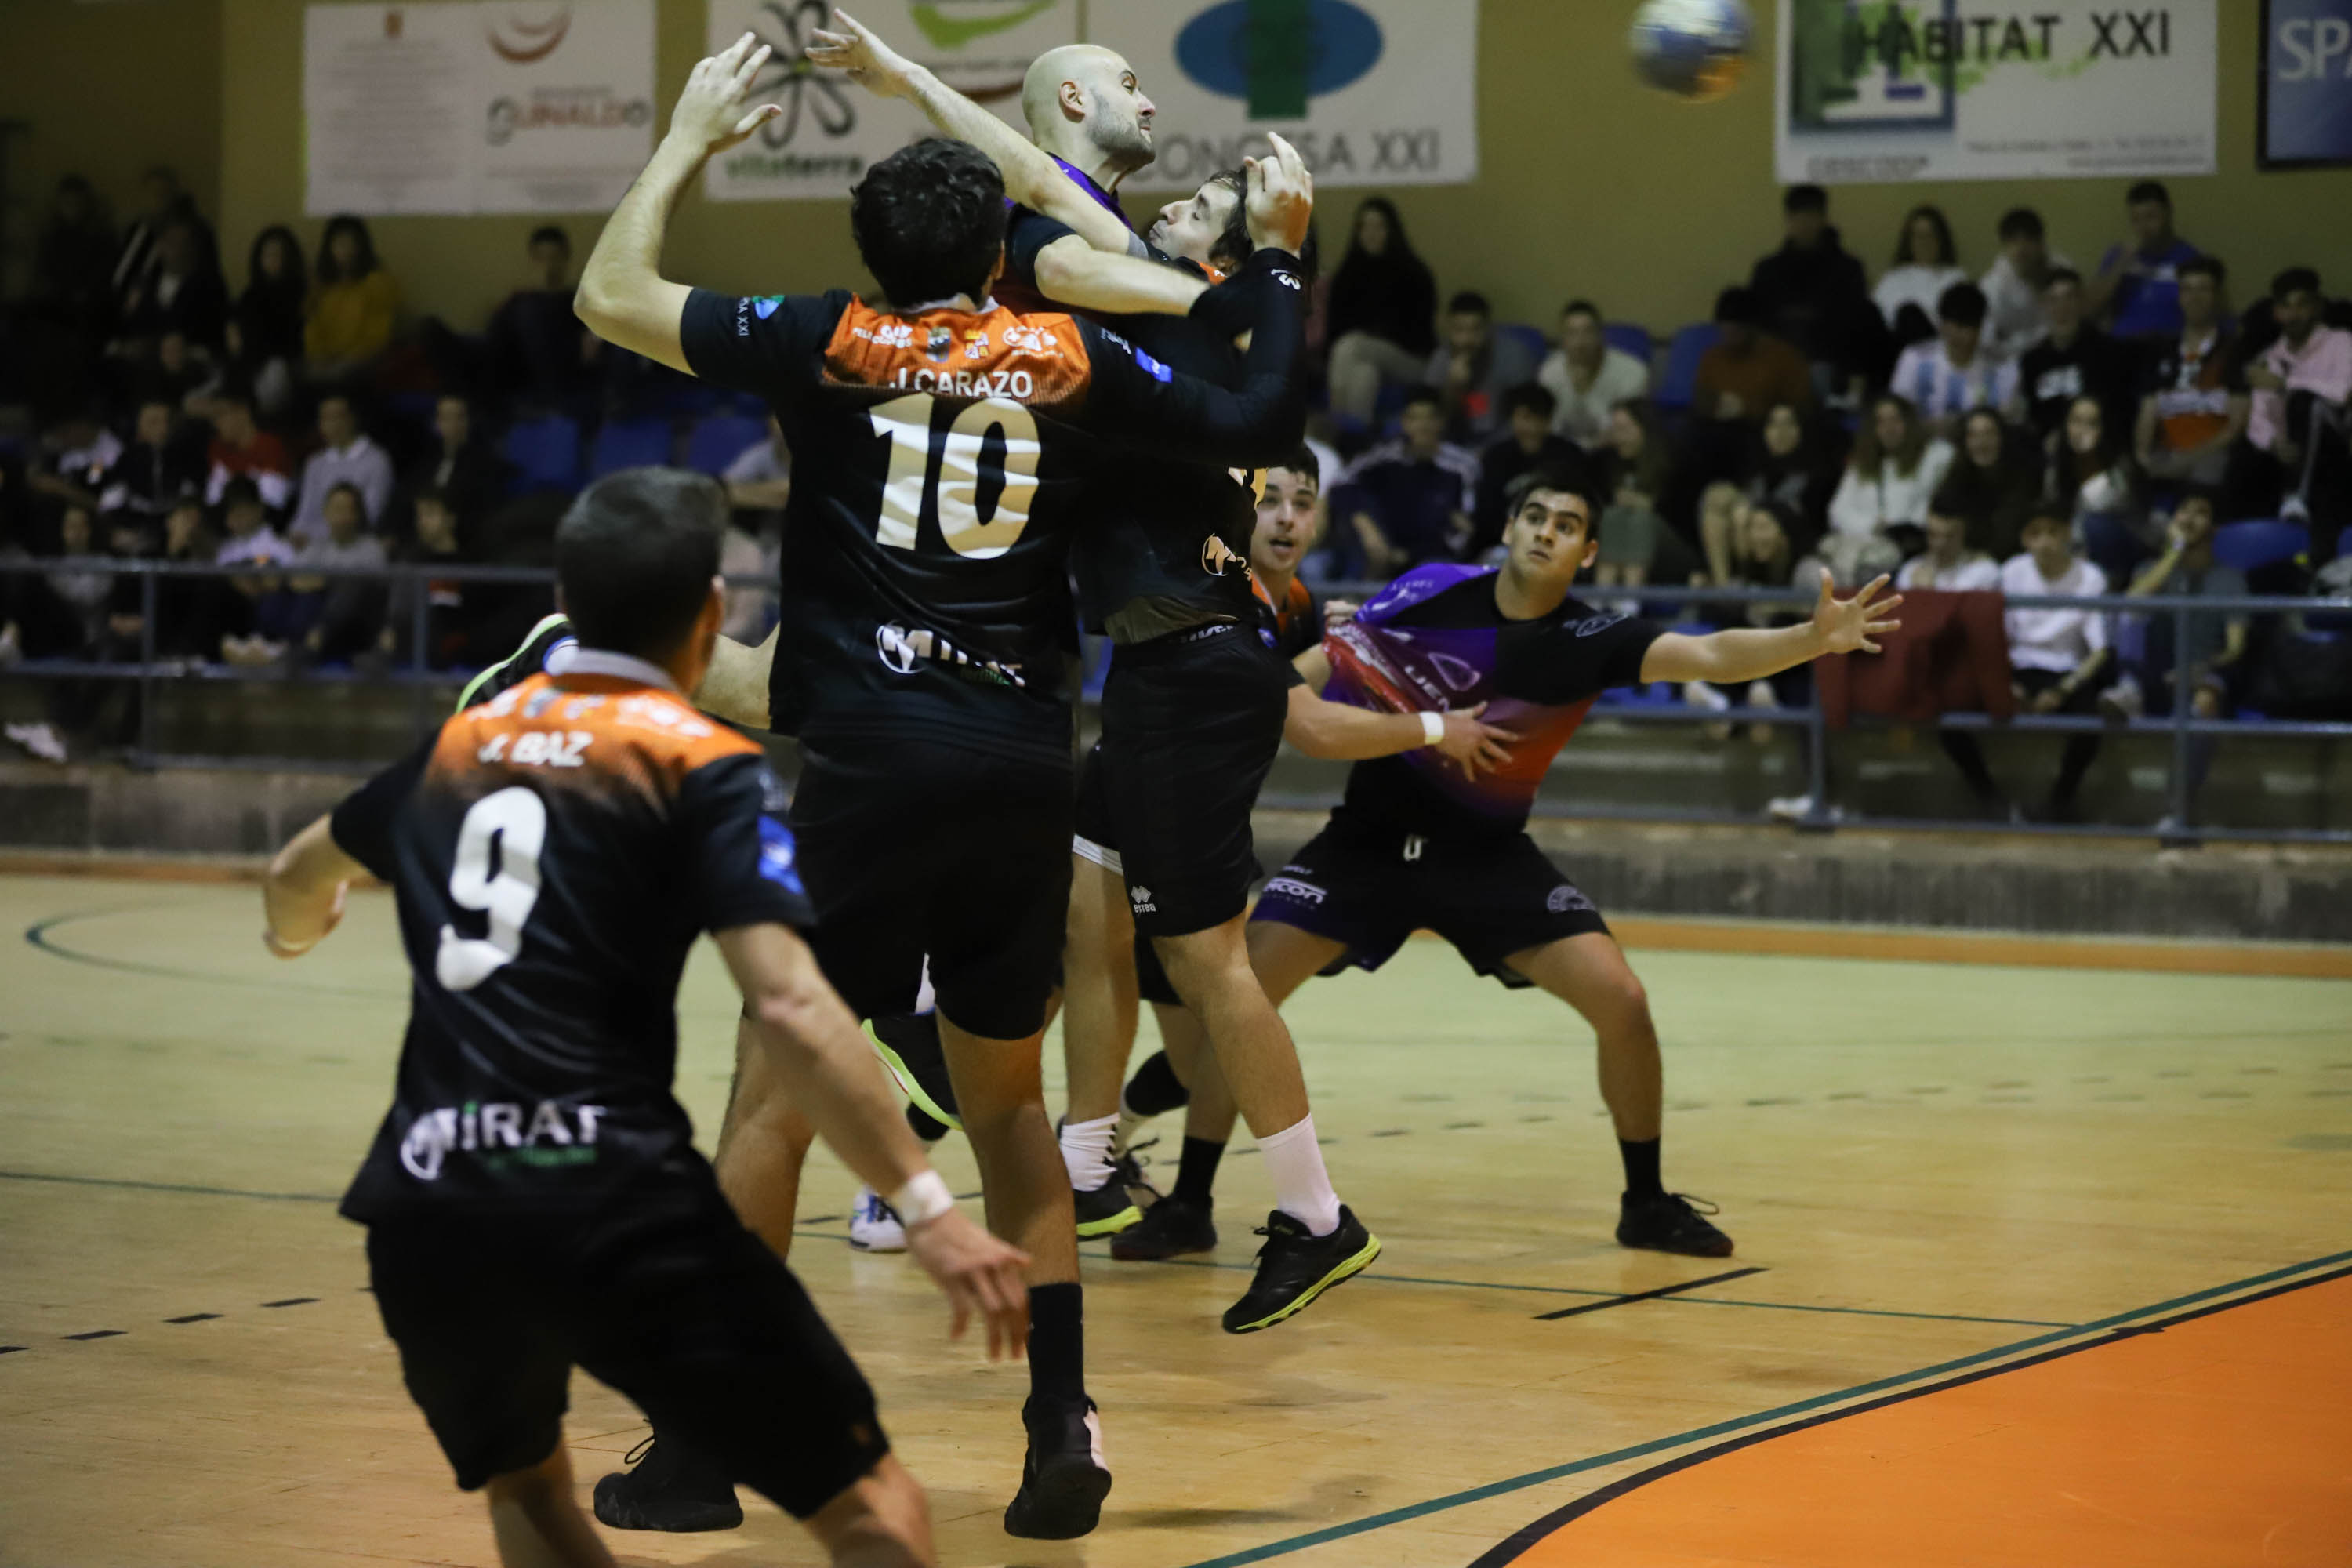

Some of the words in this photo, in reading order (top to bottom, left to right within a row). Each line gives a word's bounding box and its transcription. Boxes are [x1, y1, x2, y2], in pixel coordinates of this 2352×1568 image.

[1857, 14, 2063, 64] HABITAT
[2089, 9, 2170, 58] XXI
[2277, 18, 2352, 81] SP
[1369, 127, 1441, 174] XXI
[914, 369, 1033, 399] CARAZO
[869, 391, 1041, 560] 10
[510, 731, 594, 767] BAZ
[436, 786, 547, 992] 9
